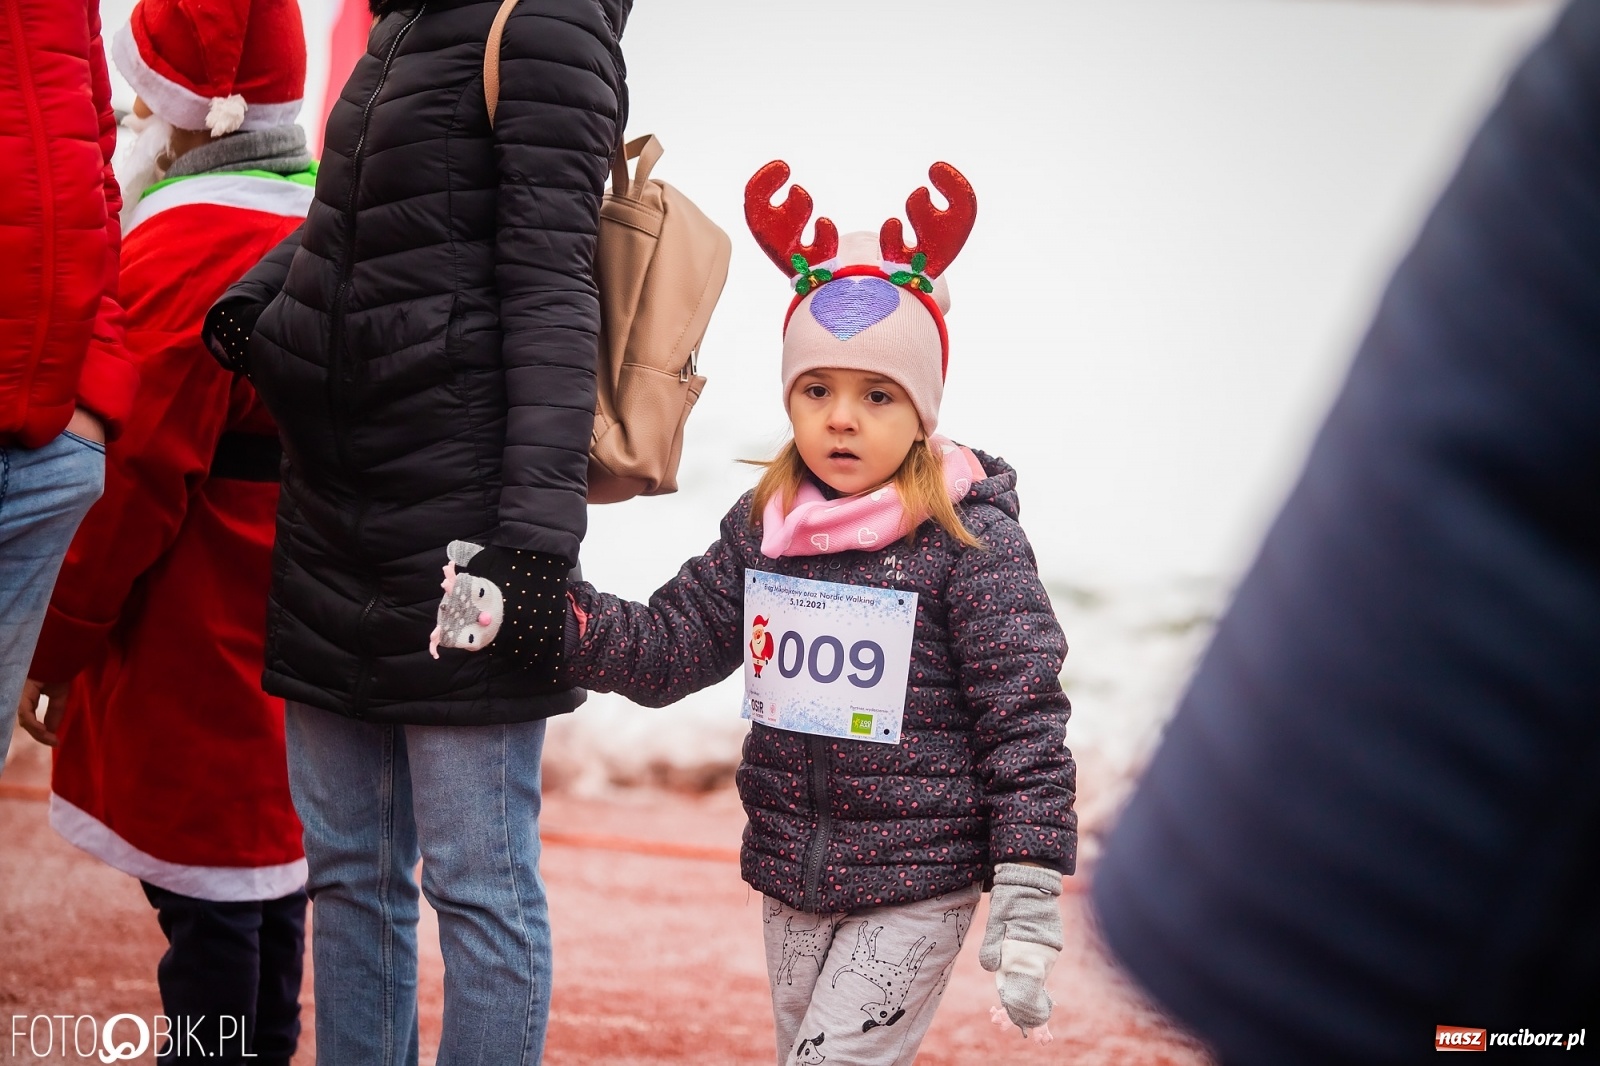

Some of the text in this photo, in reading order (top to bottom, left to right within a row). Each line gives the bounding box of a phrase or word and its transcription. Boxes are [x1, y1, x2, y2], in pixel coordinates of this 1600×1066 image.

[789, 598, 826, 609] 5.12.2021
[820, 592, 844, 601] Nordic
[846, 594, 875, 606] Walking
[778, 630, 885, 689] 009
